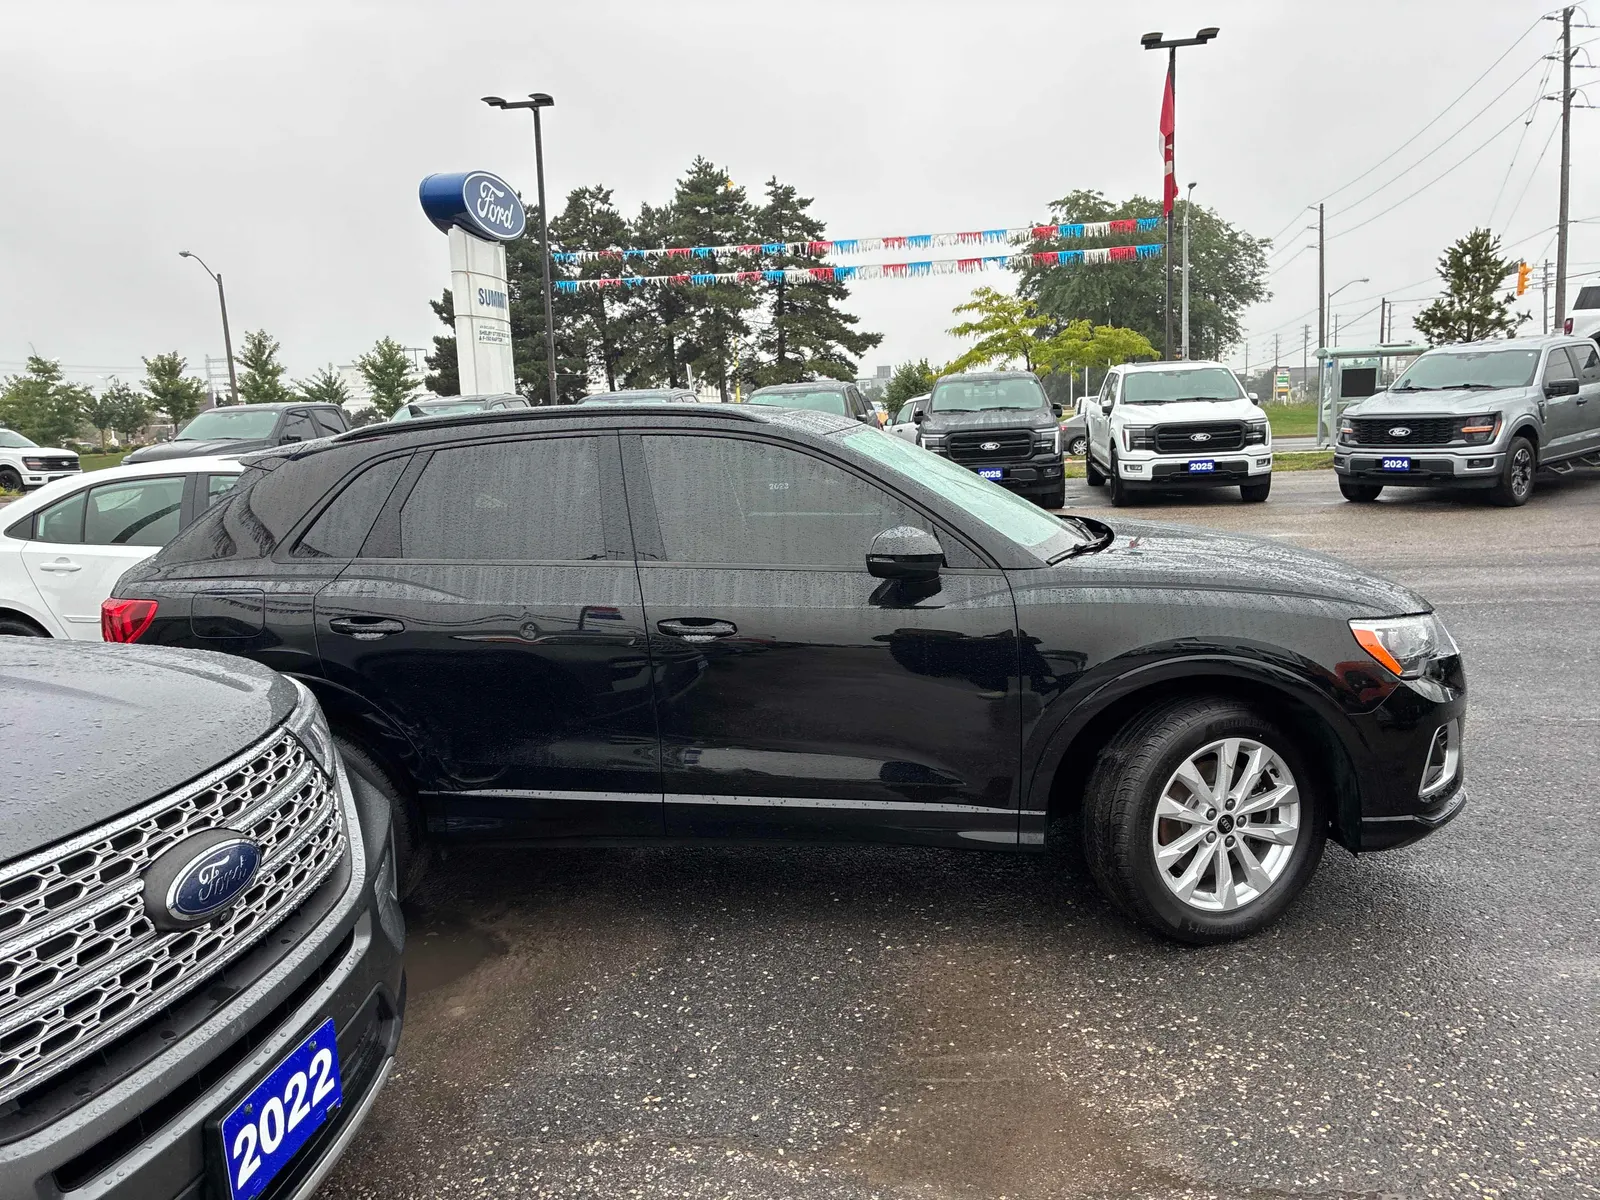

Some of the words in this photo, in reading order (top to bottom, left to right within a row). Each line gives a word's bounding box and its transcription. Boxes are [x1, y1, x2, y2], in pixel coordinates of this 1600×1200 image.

[477, 181, 514, 229] Ford
[1390, 428, 1409, 436] Ford
[1191, 433, 1210, 441] Ford
[981, 442, 999, 450] Ford
[1190, 462, 1213, 470] 2025
[1383, 460, 1408, 468] 2024
[980, 470, 1001, 478] 2025
[199, 855, 247, 901] Ford
[233, 1048, 335, 1190] 2022
